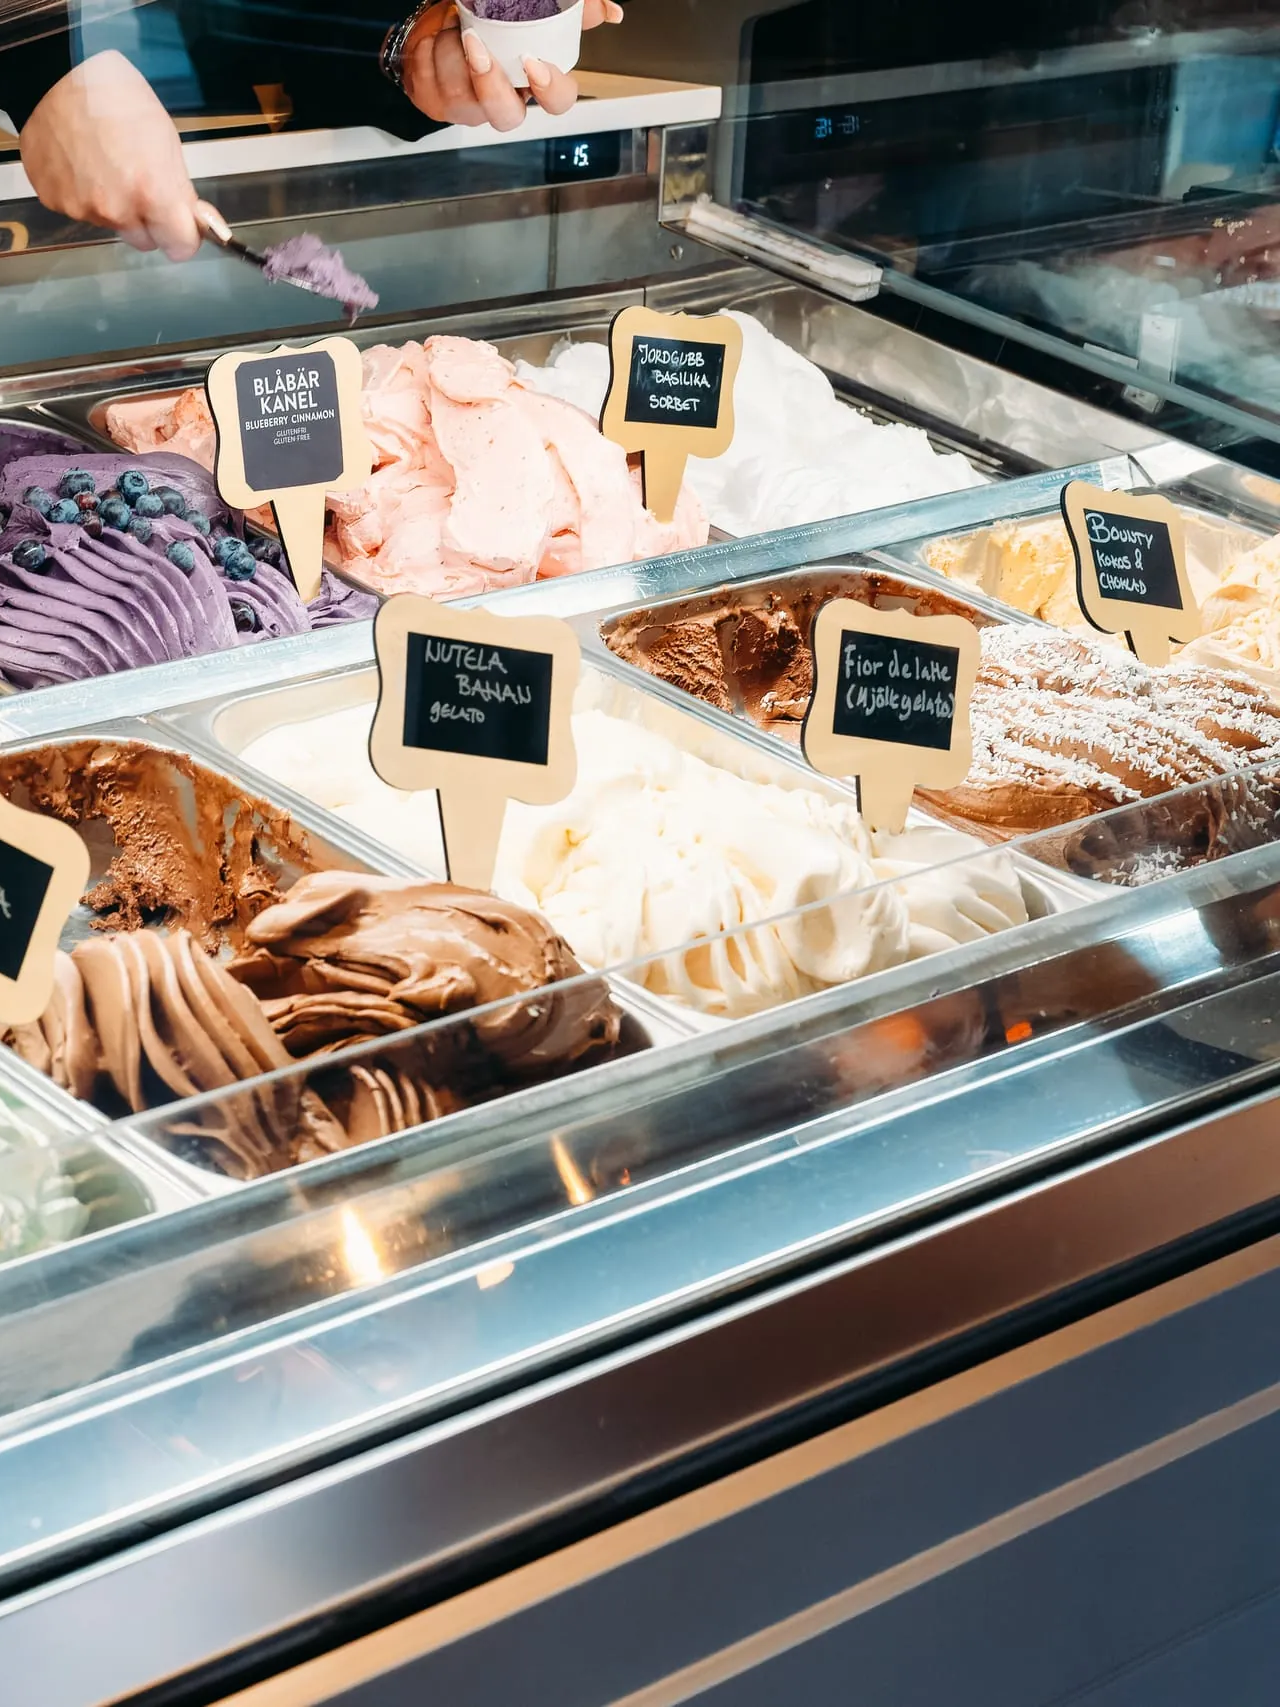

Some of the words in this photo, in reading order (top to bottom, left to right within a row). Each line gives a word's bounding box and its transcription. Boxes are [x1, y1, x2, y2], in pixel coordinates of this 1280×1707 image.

[638, 344, 705, 367] JORDGUBB
[253, 367, 320, 396] BLÅBÄR
[654, 369, 711, 389] BASILIKA
[260, 390, 318, 414] KANEL
[649, 394, 700, 411] SORBET
[245, 415, 289, 430] BLUEBERRY
[291, 409, 335, 423] CINNAMON
[276, 427, 307, 437] GLUTENFRI
[1134, 548, 1144, 570] &
[425, 639, 508, 674] NUTELA
[844, 644, 883, 679] Fior
[888, 649, 912, 679] de
